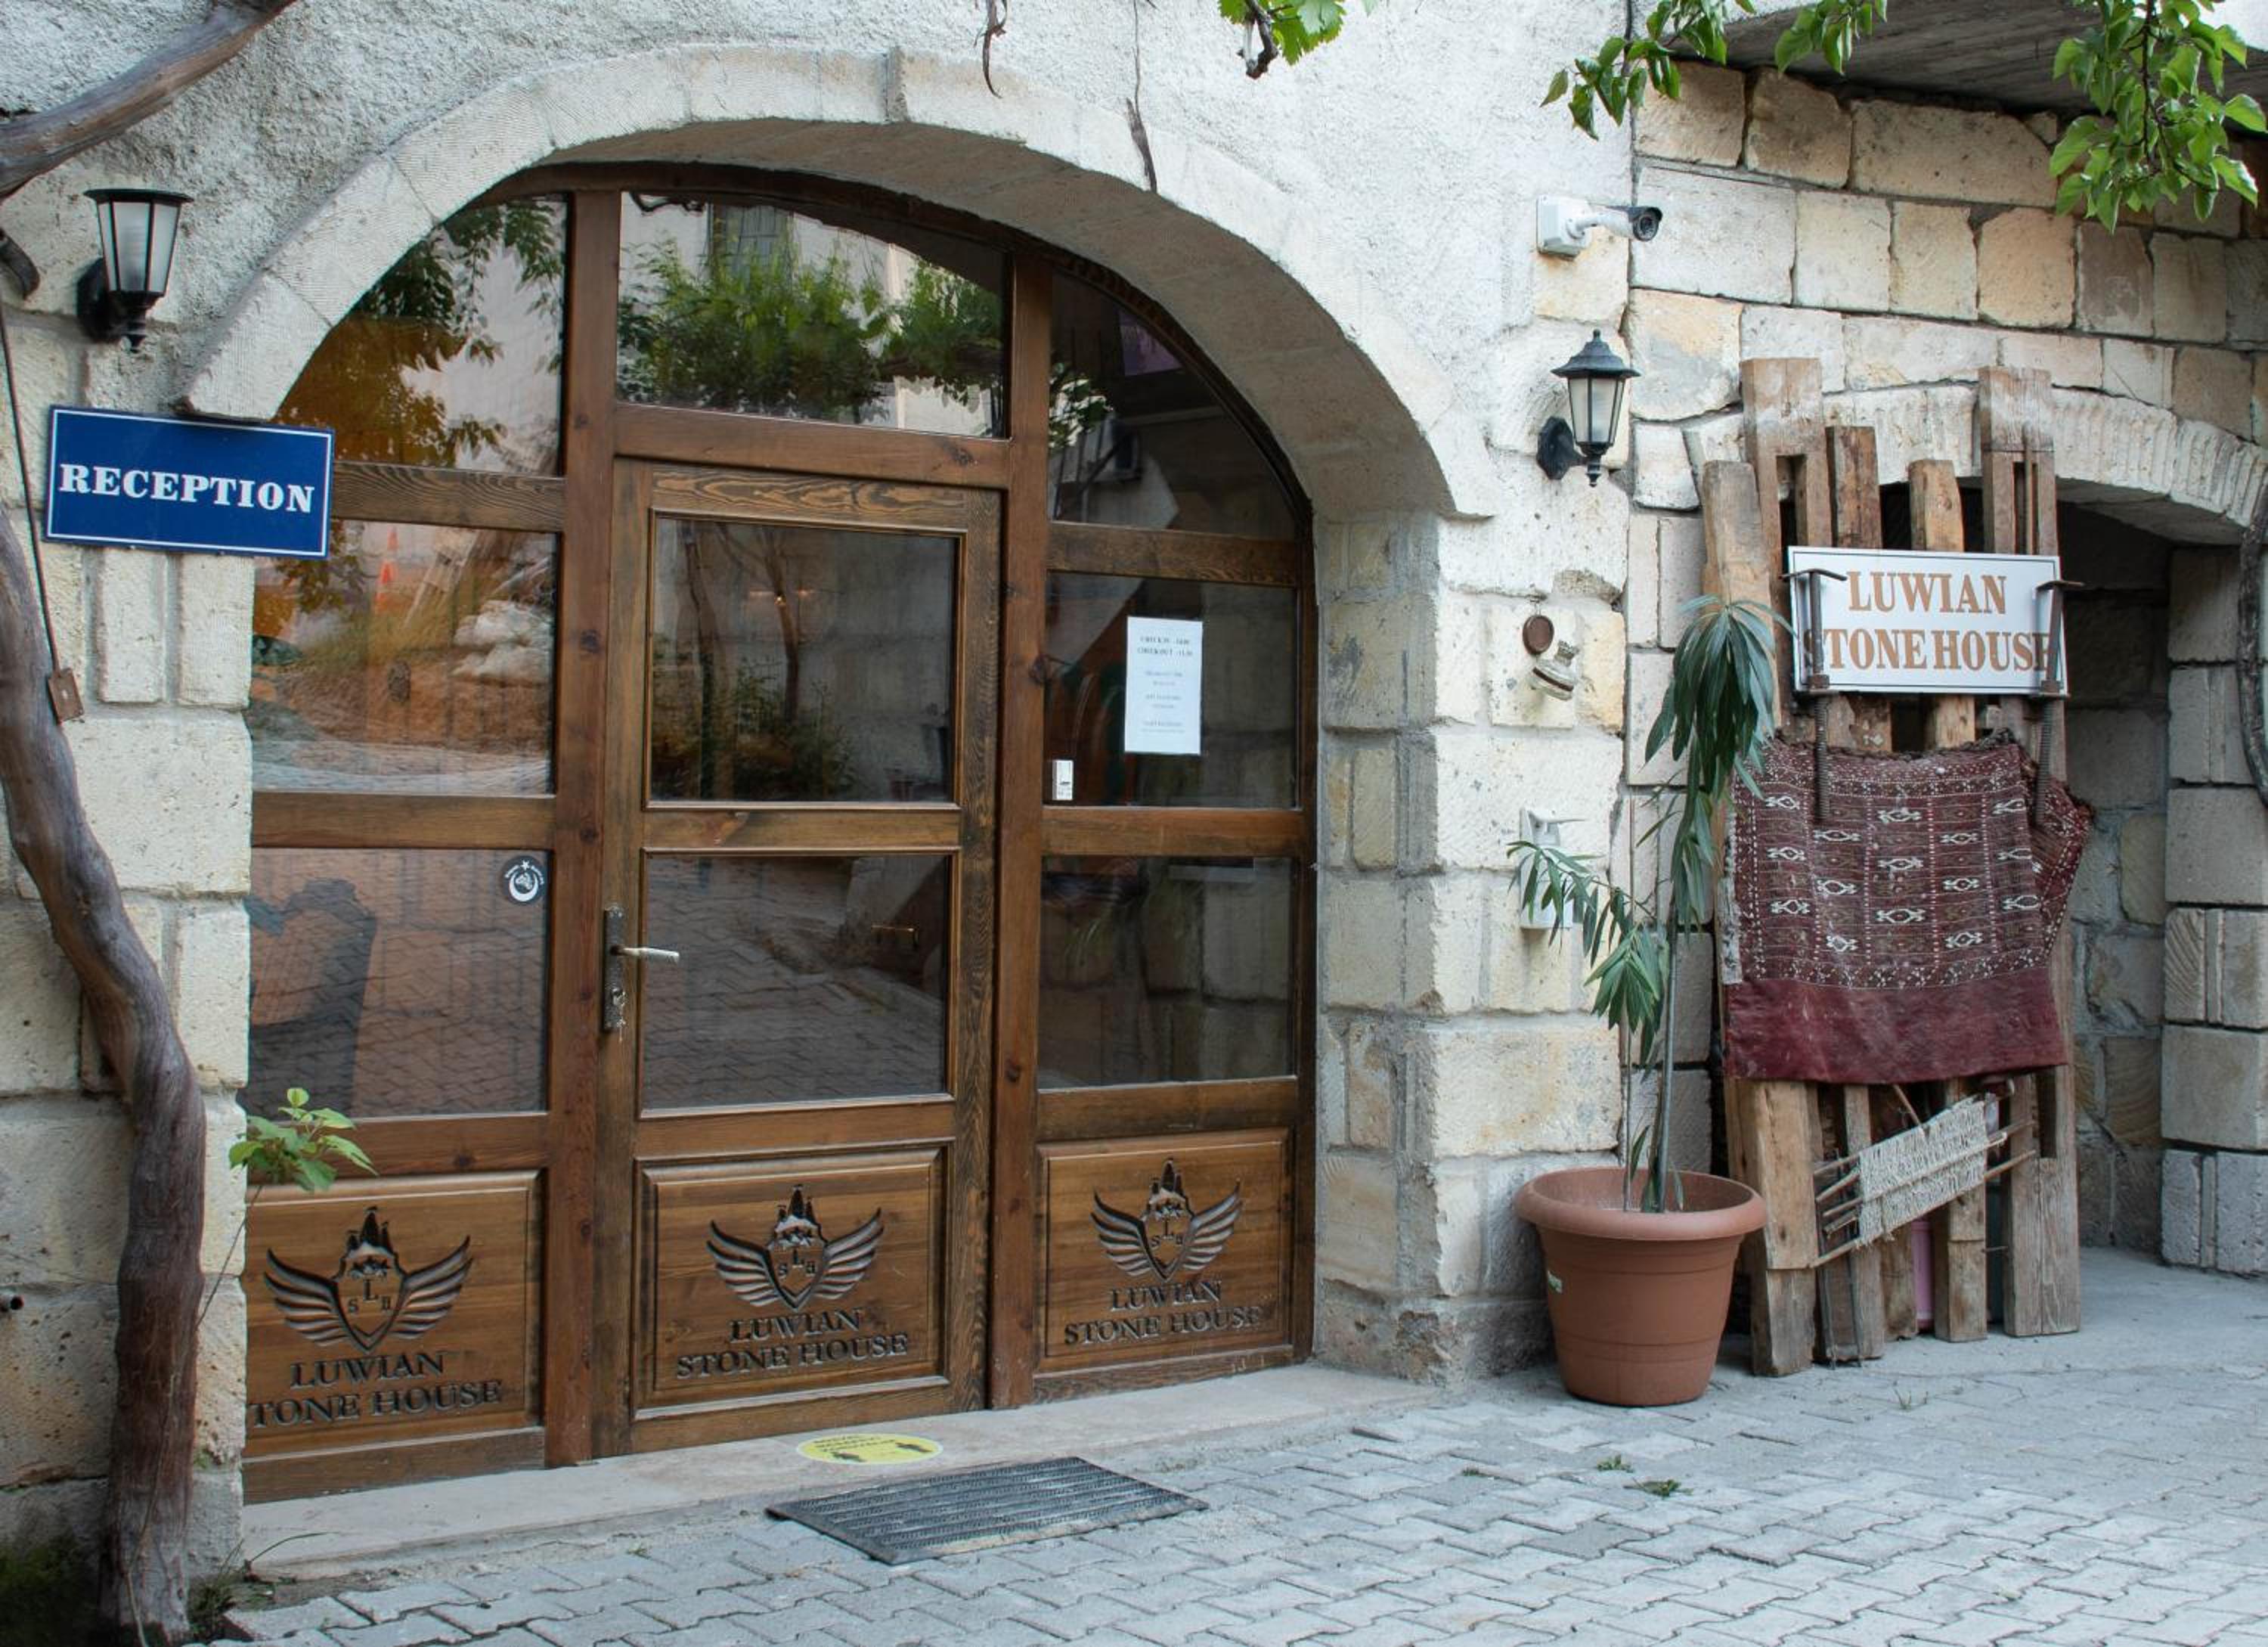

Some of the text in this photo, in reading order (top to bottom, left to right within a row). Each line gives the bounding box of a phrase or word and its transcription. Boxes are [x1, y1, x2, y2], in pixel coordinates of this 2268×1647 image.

[59, 463, 314, 513] RECEPTION
[1846, 571, 2007, 615] LUWIAN
[1932, 630, 2050, 672] HOUSE
[347, 1297, 360, 1314] S
[363, 1279, 380, 1303] L
[1110, 1281, 1222, 1312] LUWIAN
[729, 1307, 865, 1344] LUWIAN
[1064, 1306, 1261, 1345] STONE HOUSE
[290, 1352, 445, 1390] LUWIAN
[677, 1332, 909, 1379] STONE HOUSE
[247, 1379, 503, 1428] TONE HOUSE
